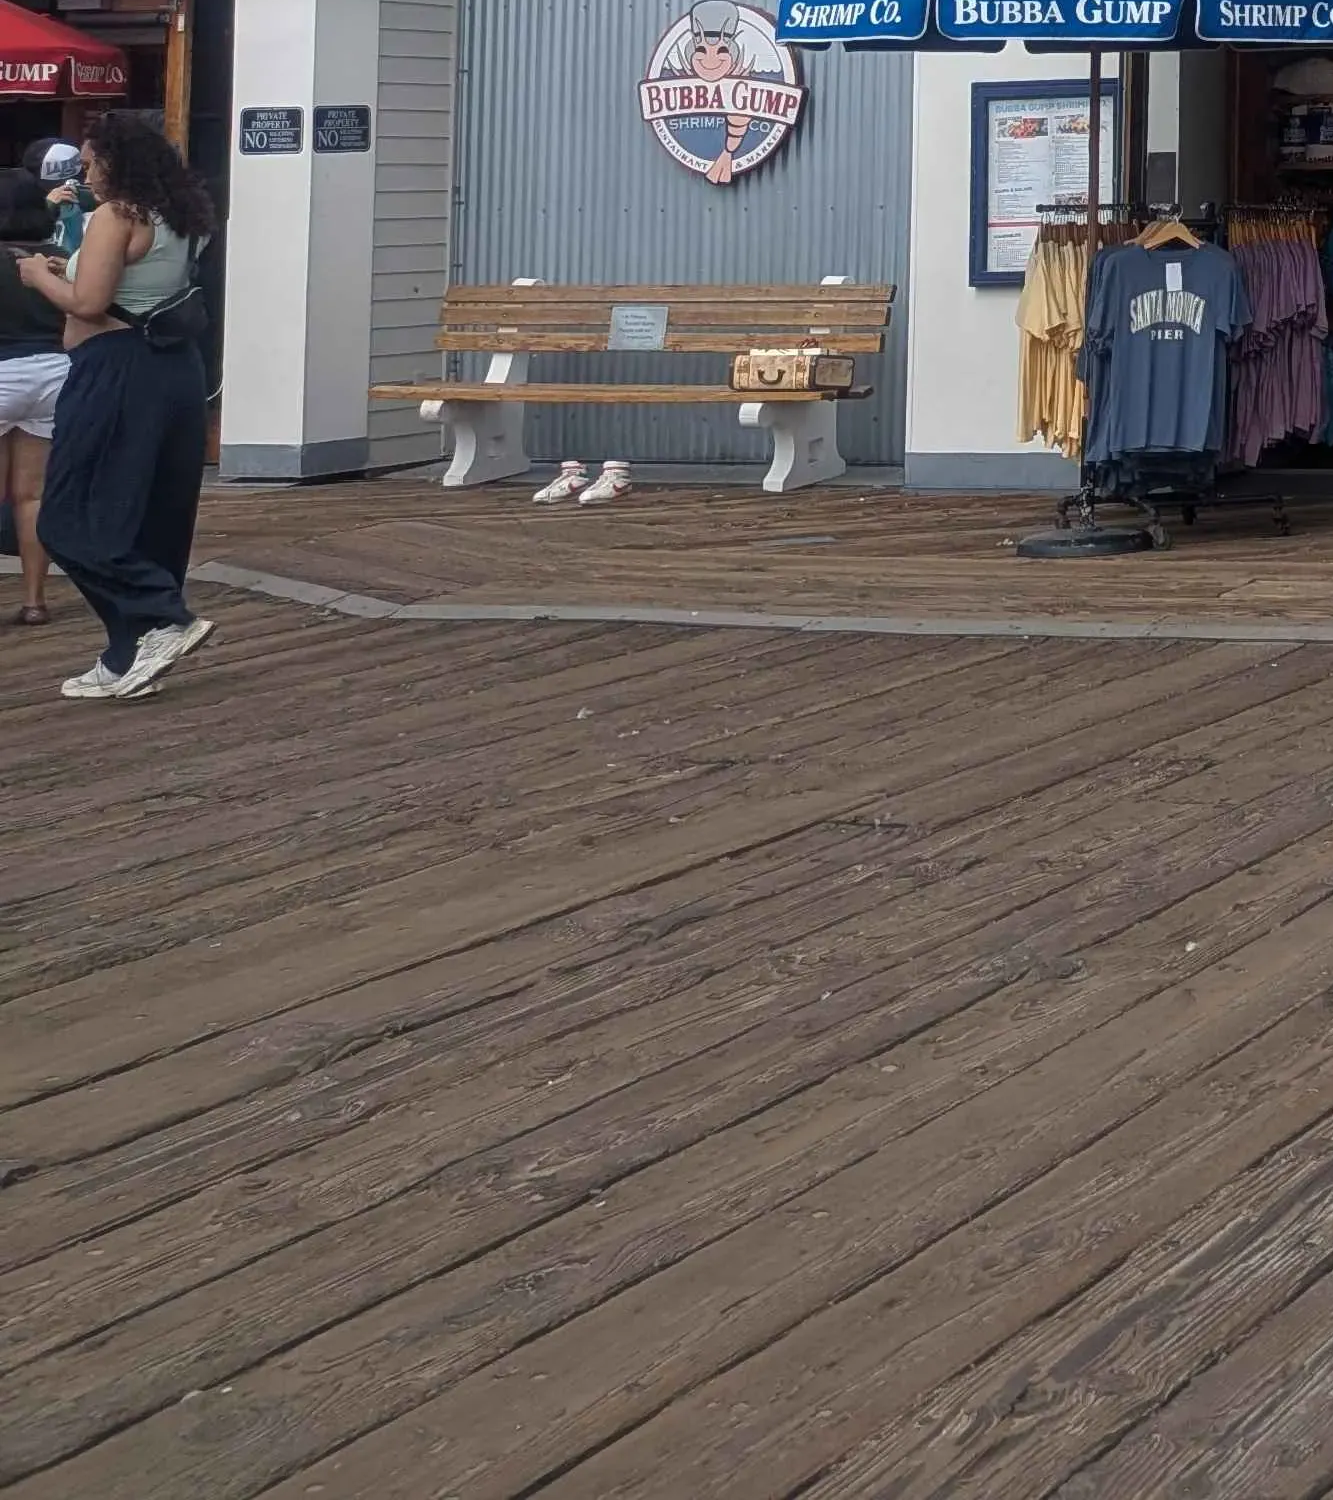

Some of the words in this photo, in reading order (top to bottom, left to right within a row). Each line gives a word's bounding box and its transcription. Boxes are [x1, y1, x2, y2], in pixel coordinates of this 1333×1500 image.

[785, 1, 866, 29] SHRIMP
[1219, 0, 1307, 29] SHRIMP
[646, 83, 726, 115] BUBBA
[731, 80, 798, 119] GUMP
[317, 129, 339, 147] NO
[669, 116, 725, 131] SHRIMP
[749, 119, 771, 133] CO
[244, 131, 268, 149] NO
[654, 119, 708, 171] RESTAURANT
[745, 126, 784, 165] MARKET
[1129, 288, 1164, 335] SANTA
[1164, 290, 1206, 335] MONICA
[1150, 329, 1184, 341] PIER
